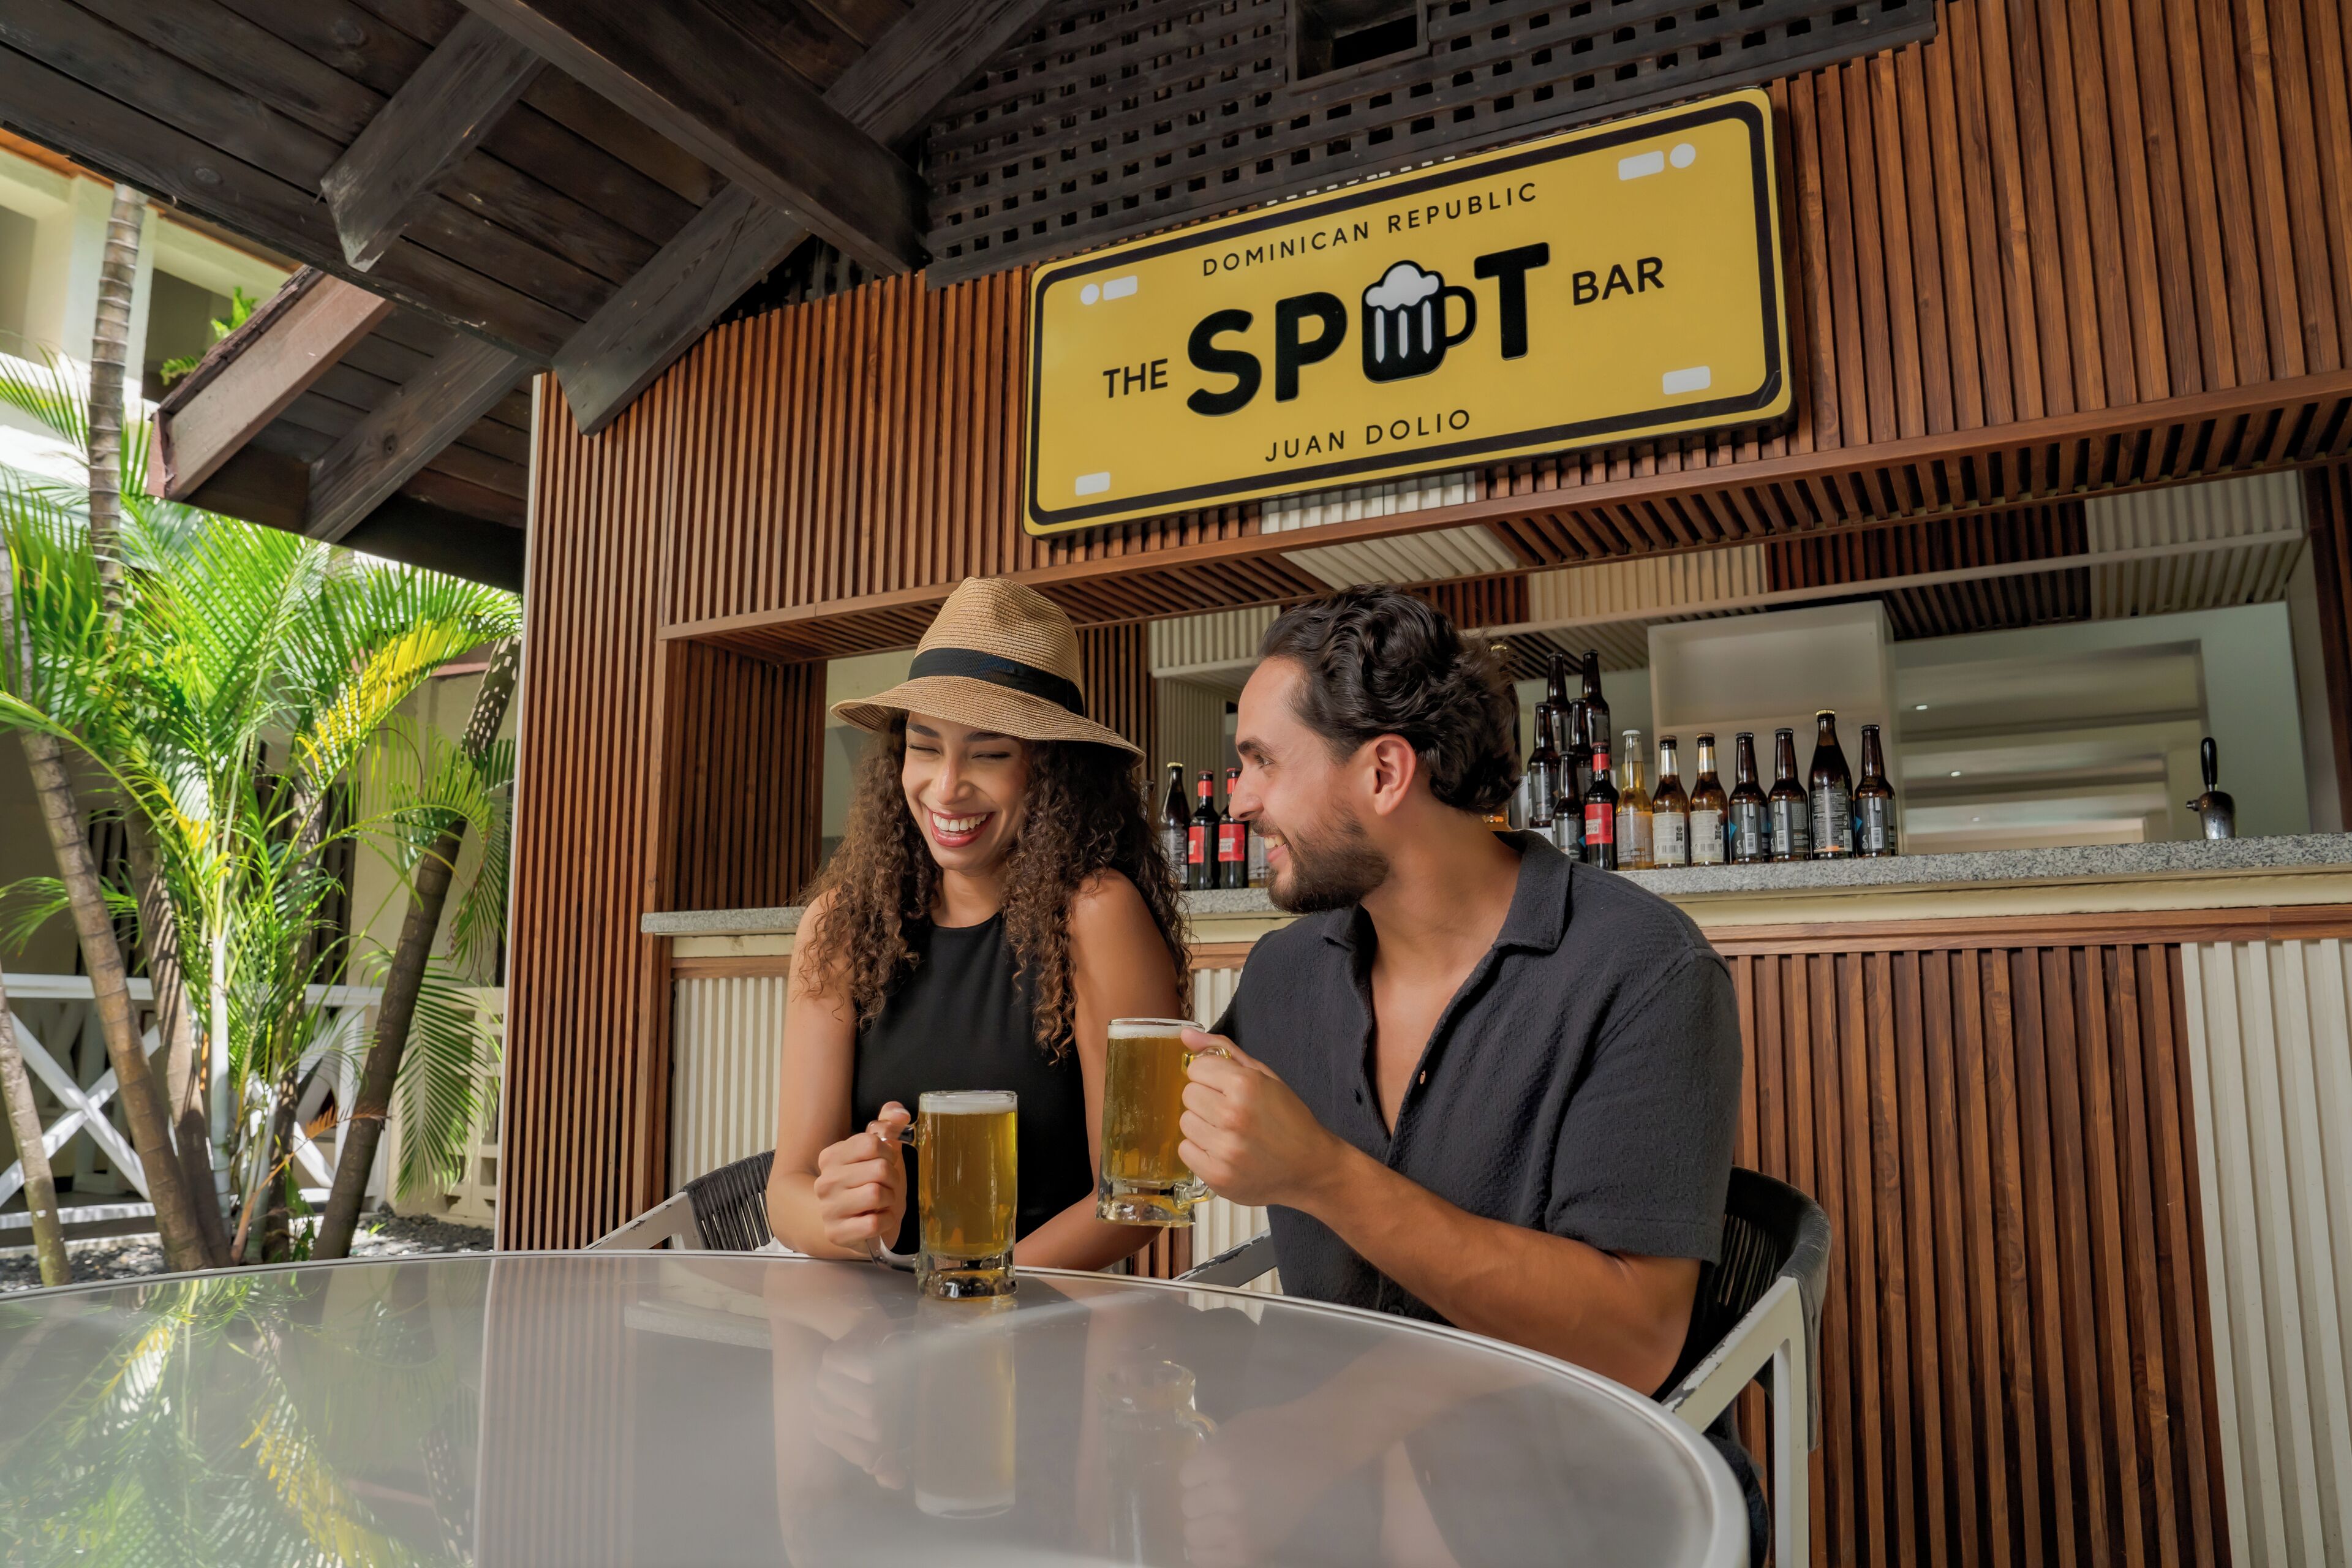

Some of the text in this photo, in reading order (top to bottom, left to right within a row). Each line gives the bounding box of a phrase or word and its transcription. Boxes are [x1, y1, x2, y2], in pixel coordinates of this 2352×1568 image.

[1202, 182, 1538, 277] DOMINICAN REPUBLIC
[1101, 357, 1169, 399] THE
[1572, 255, 1665, 306] BAR
[1264, 409, 1471, 463] JUAN DOLIO
